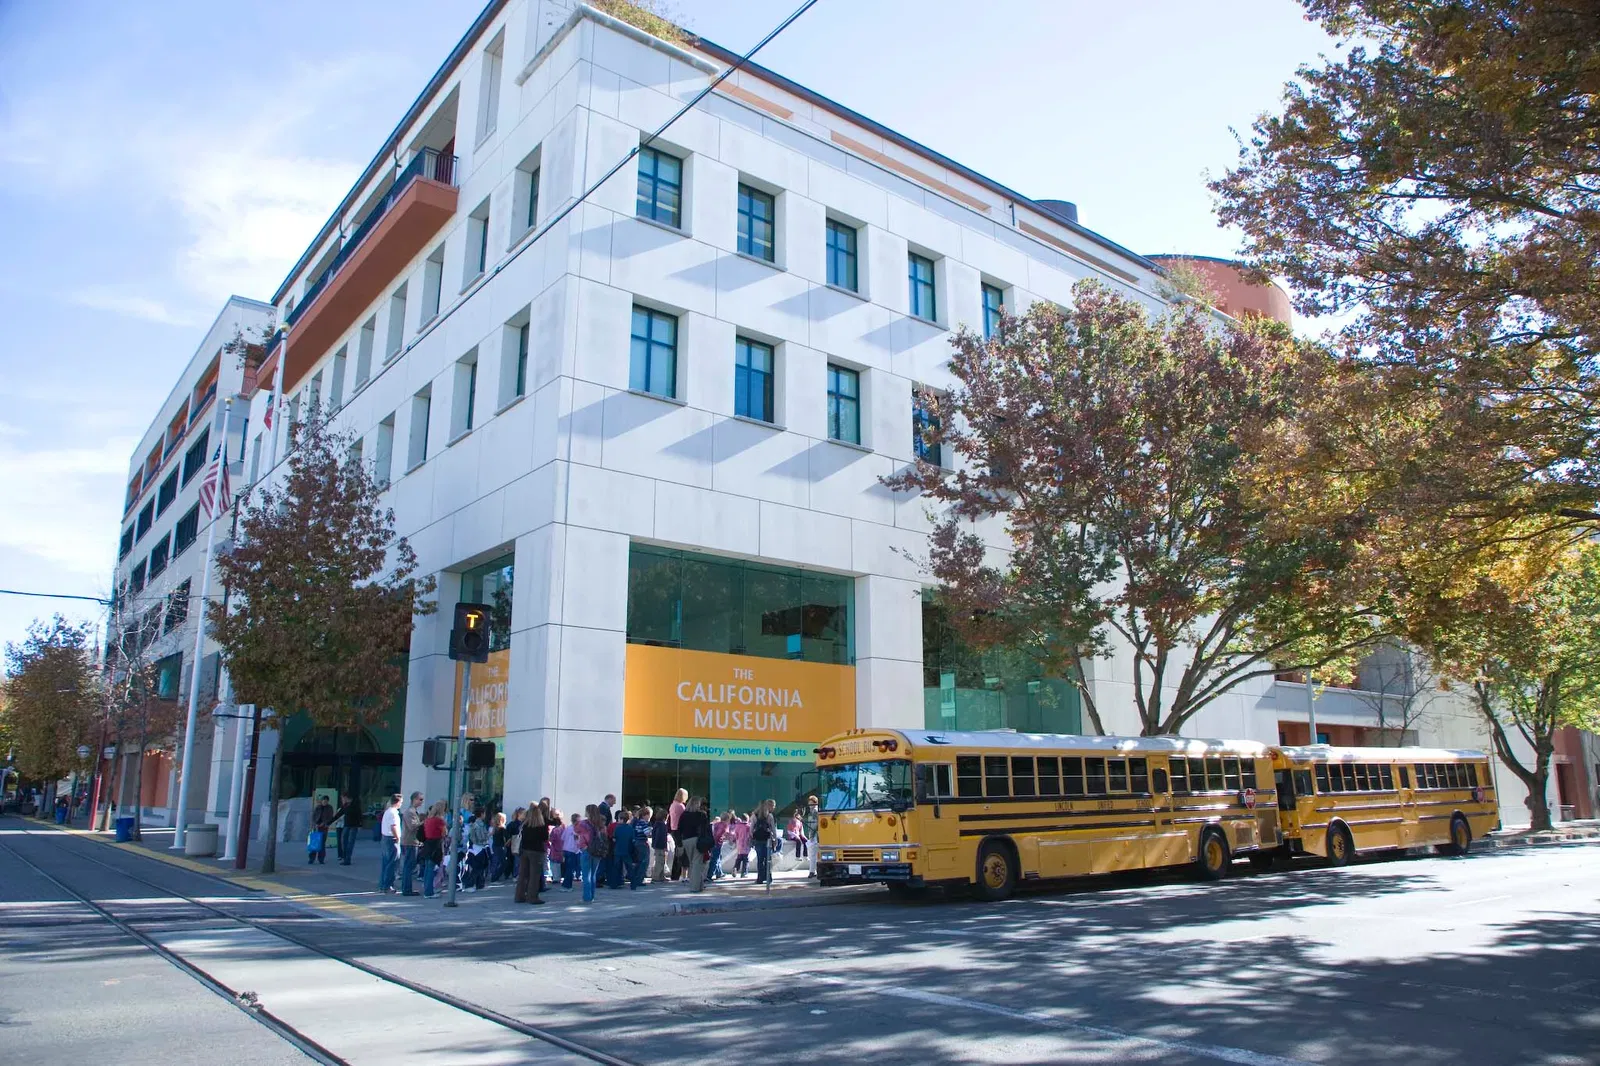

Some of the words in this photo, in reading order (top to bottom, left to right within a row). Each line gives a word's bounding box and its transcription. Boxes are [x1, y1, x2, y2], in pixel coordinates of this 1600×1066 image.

[733, 667, 754, 680] THE
[469, 682, 508, 704] ALIFOR
[676, 681, 803, 708] CALIFORNIA
[694, 708, 788, 732] MUSEUM
[674, 743, 689, 753] for
[691, 744, 726, 757] history,
[728, 746, 762, 756] women
[764, 747, 771, 756] &
[774, 747, 788, 757] the
[790, 749, 807, 757] arts
[838, 741, 861, 757] SCHOOL
